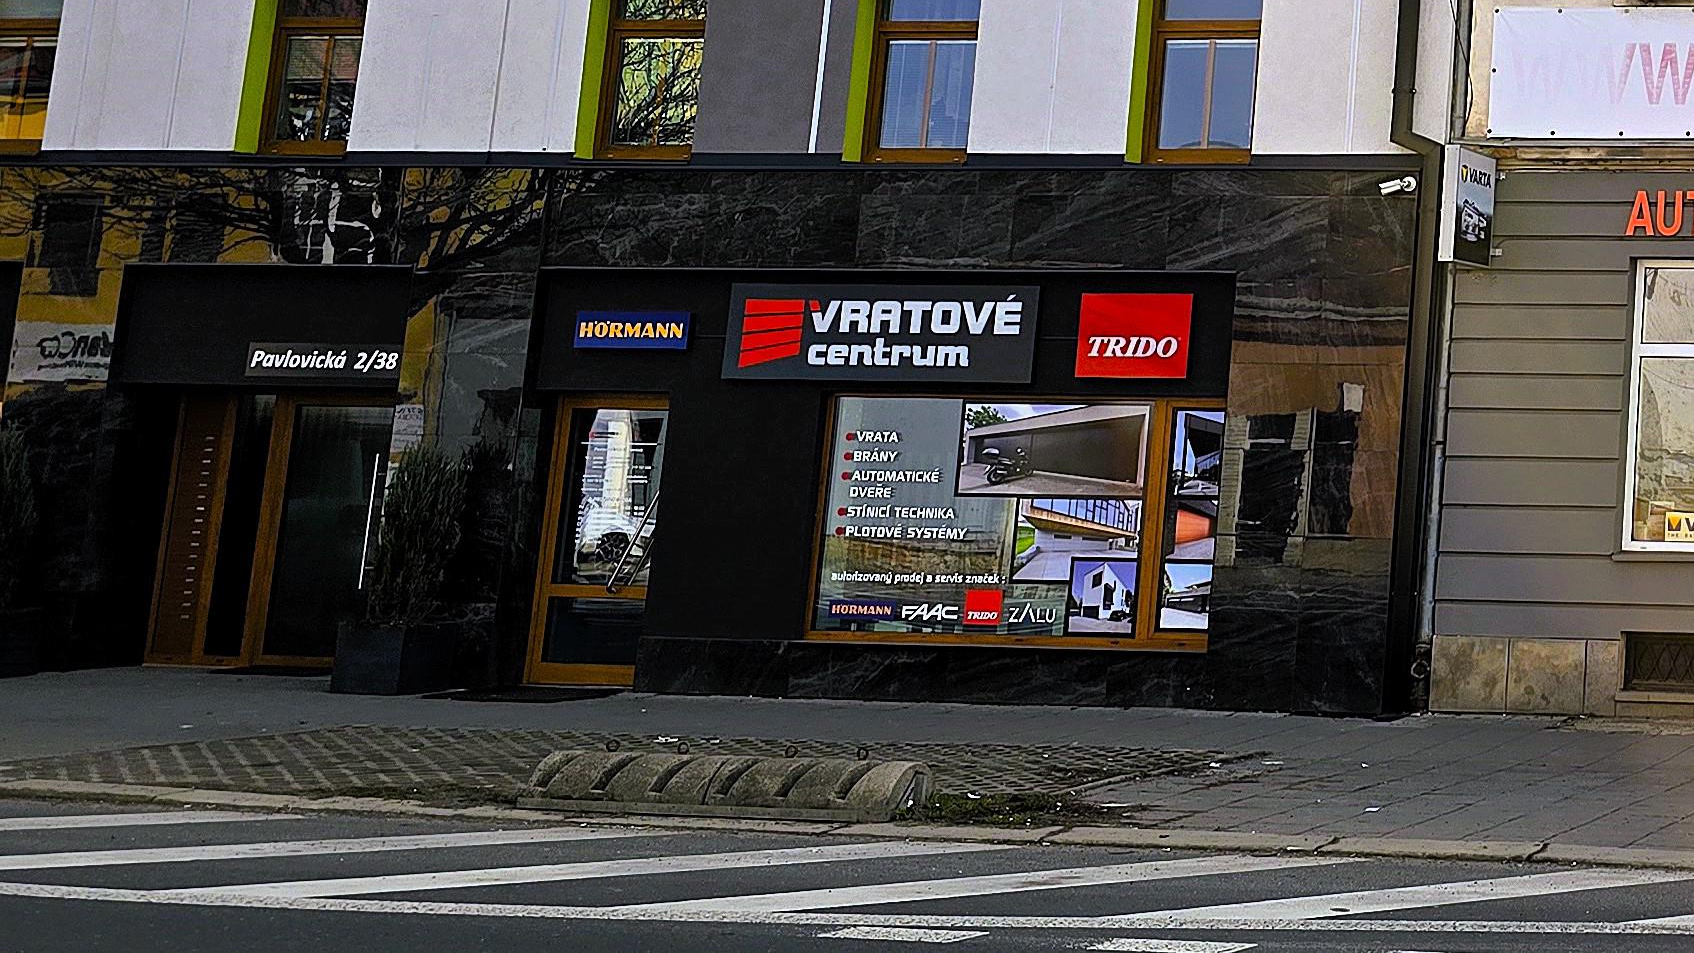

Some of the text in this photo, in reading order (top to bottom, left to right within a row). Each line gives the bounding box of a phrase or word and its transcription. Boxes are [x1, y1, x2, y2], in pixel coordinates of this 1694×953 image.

[1469, 167, 1492, 189] VARTA
[808, 294, 1023, 335] VRATOVÉ
[578, 319, 684, 339] HÖRMANN
[806, 338, 970, 368] centrum
[1087, 335, 1179, 358] TRIDO
[250, 349, 399, 373] Pavlovická 2/38
[855, 430, 899, 443] VRATA
[853, 447, 898, 462] BRÁNY
[851, 467, 940, 483] AUTOMATICKÉ
[849, 483, 892, 498] DVEŘE
[846, 503, 955, 520] STÍNICÍ TECHNIKA
[845, 523, 968, 540] PLOTOVÉ SYSTÉMY
[831, 570, 892, 584] autorizovaný
[893, 571, 924, 585] prodej
[925, 575, 933, 583] a
[934, 572, 963, 584] servis
[901, 603, 960, 621] FAAC
[966, 609, 999, 620] TRIDO
